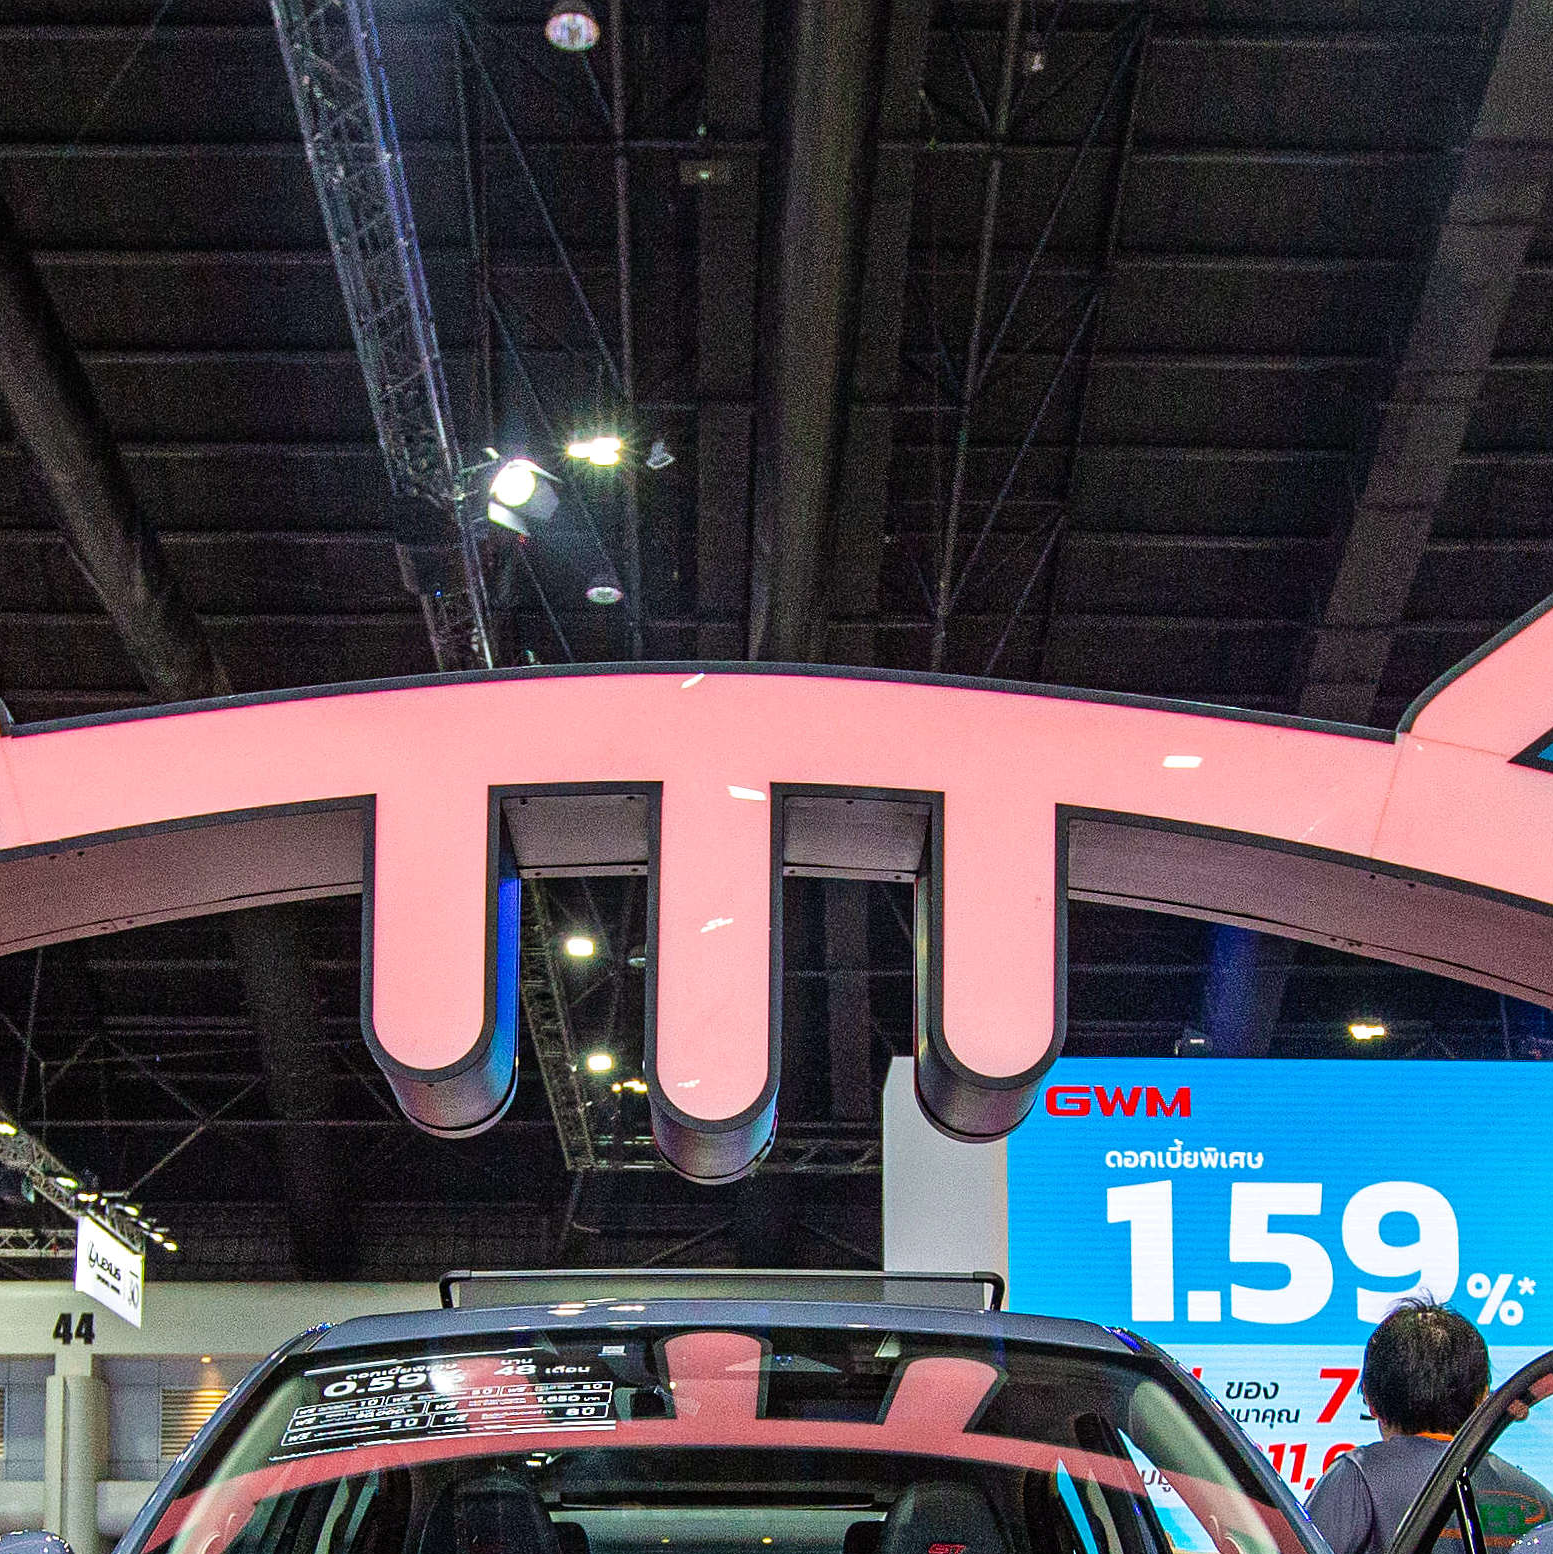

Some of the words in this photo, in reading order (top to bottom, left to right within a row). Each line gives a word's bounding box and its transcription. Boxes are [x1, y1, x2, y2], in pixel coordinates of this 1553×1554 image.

[1045, 1085, 1192, 1118] GWM
[1105, 1138, 1265, 1169] ดอกเบี้ยพิเศษ
[53, 1313, 95, 1345] 44
[493, 1364, 536, 1376] 48
[1225, 1381, 1280, 1400] ของ
[1316, 1368, 1361, 1424] 7
